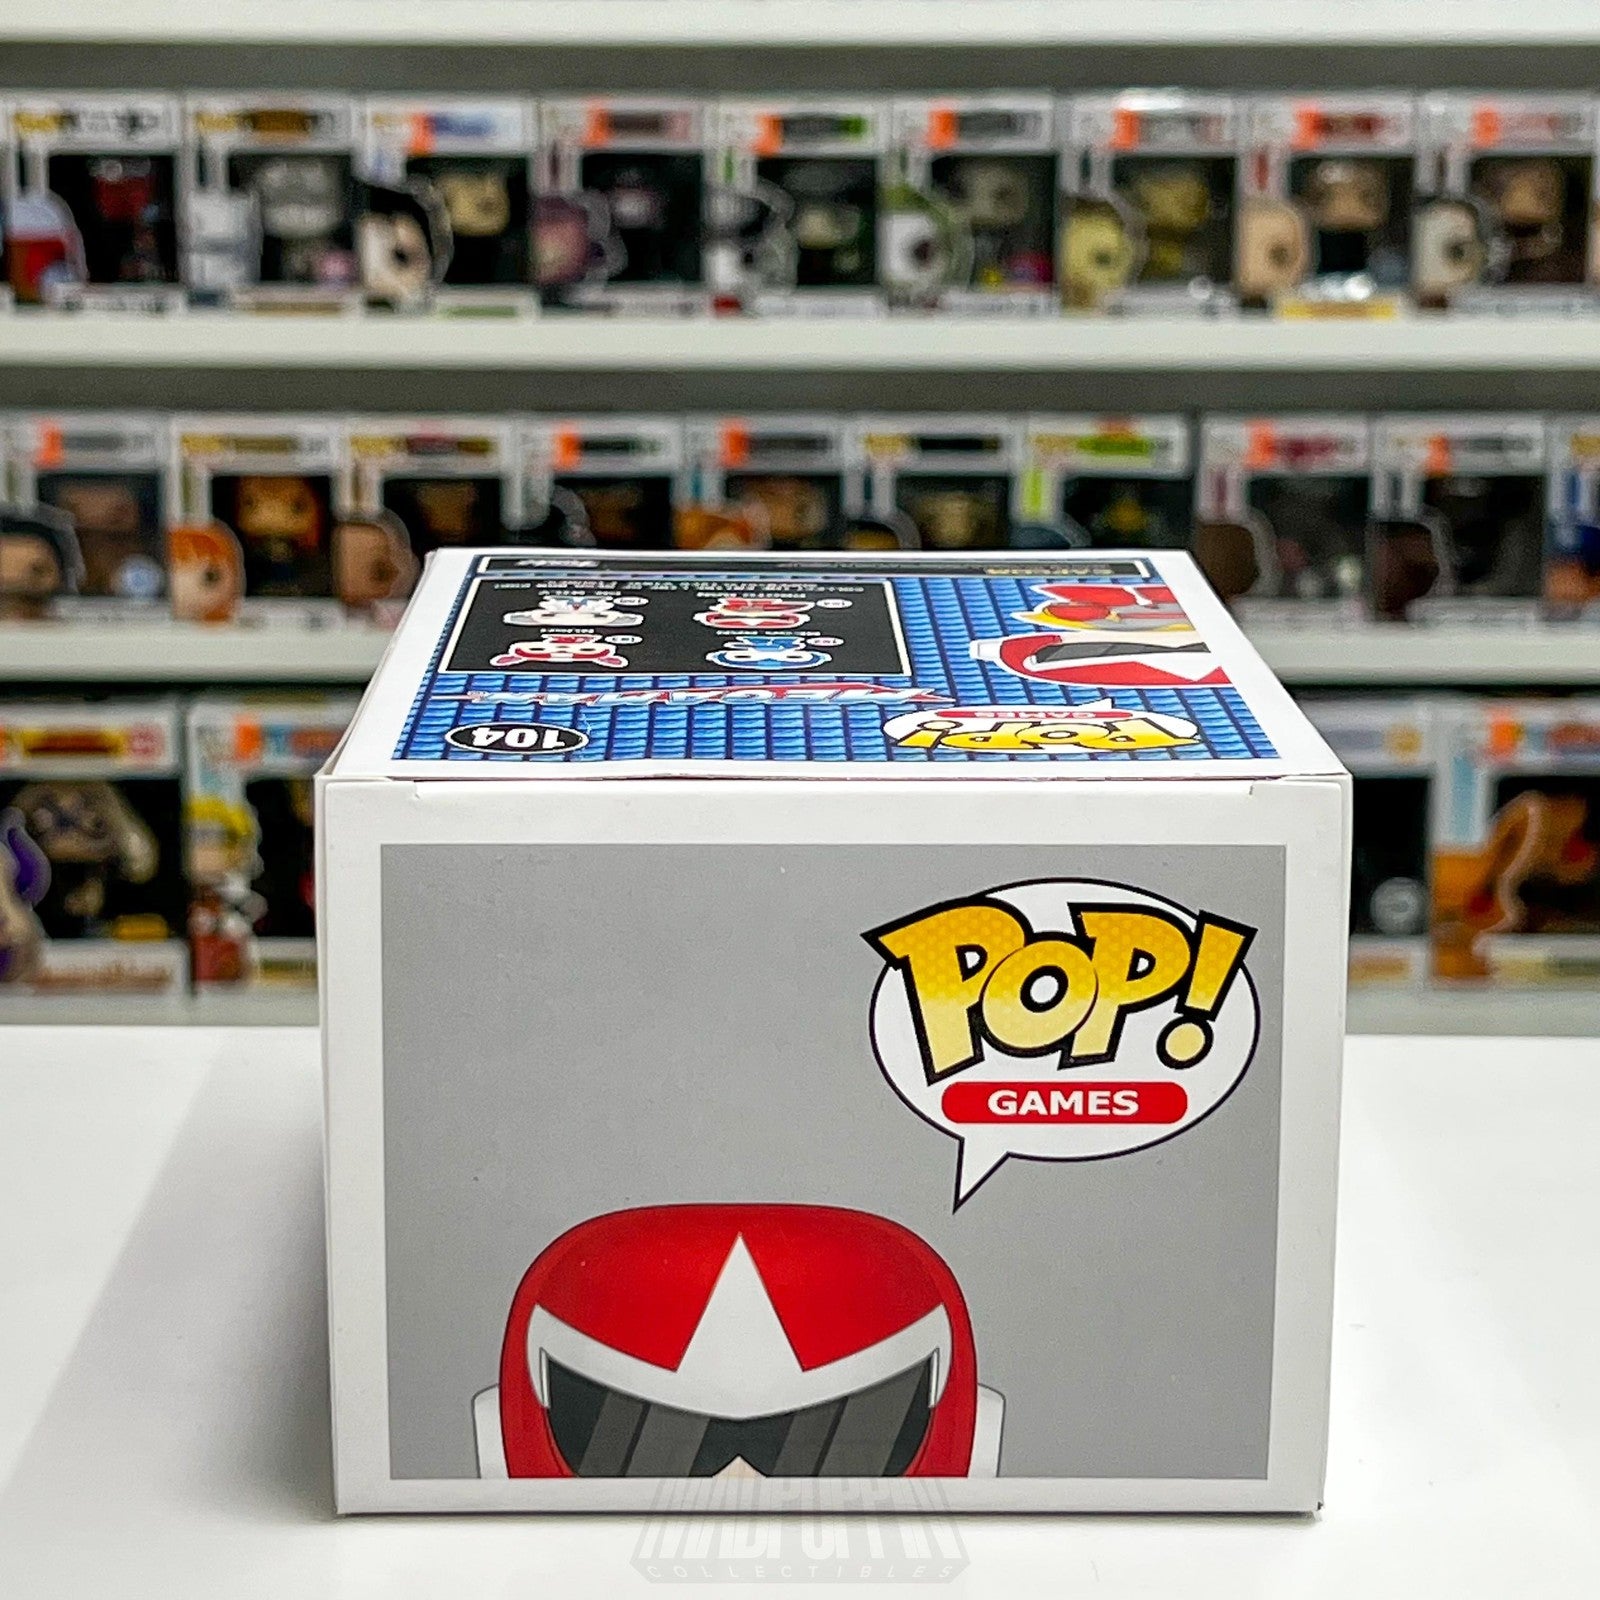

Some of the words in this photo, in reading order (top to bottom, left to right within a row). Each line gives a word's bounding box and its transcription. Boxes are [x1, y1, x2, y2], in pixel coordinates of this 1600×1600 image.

[974, 710, 1097, 719] GAMES
[470, 726, 567, 750] 104
[897, 717, 1200, 751] POP!
[860, 897, 1258, 1086] POP!
[987, 1090, 1139, 1116] GAMES
